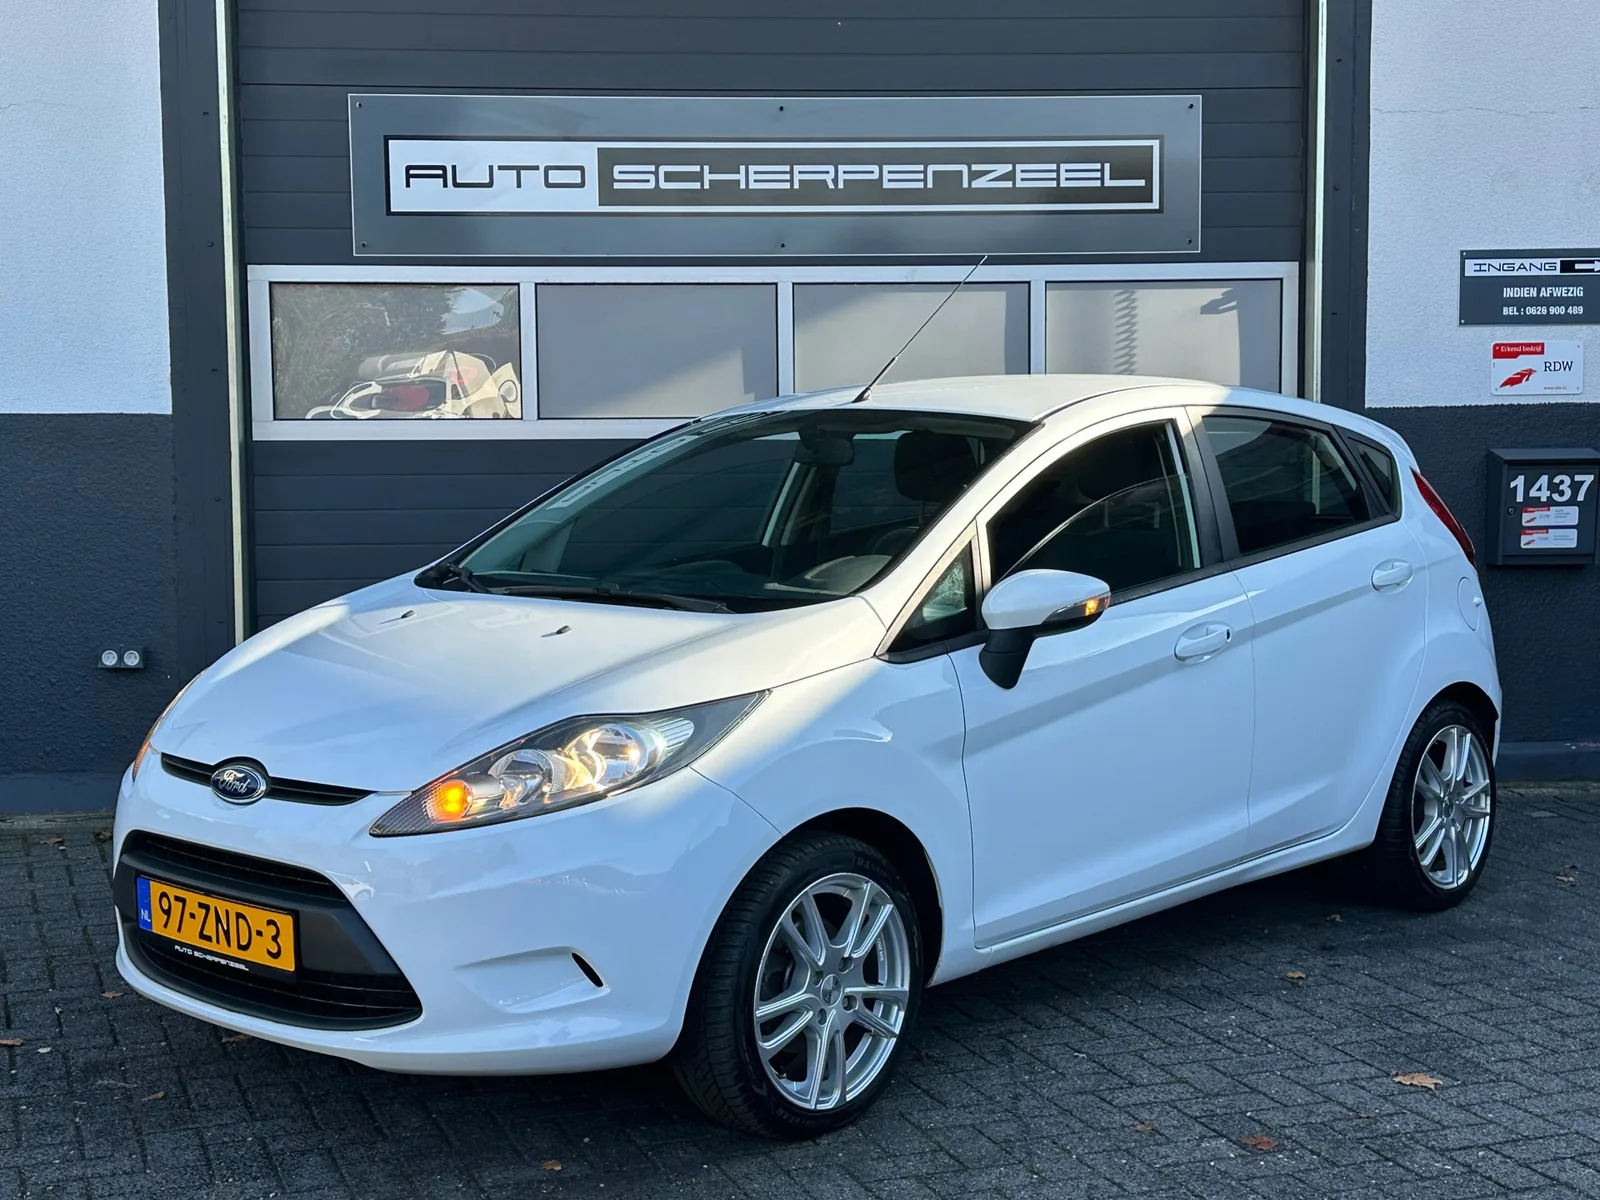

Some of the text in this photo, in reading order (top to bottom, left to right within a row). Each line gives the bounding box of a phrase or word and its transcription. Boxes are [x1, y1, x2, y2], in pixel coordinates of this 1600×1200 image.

[404, 161, 1146, 190] AUTO SCHERPENZEEL
[1473, 262, 1557, 273] INGANG
[1503, 286, 1584, 298] INDIEN AFWEZIG
[1502, 306, 1520, 316] BEL
[1525, 306, 1547, 315] 0626
[1549, 306, 1565, 315] 900
[1567, 305, 1584, 315] 489
[1543, 360, 1574, 372] RDW
[1509, 474, 1595, 503] 1437
[216, 769, 251, 794] Ford
[140, 908, 151, 923] NL
[158, 891, 282, 960] 97-ZND-3
[174, 944, 193, 955] AUTO
